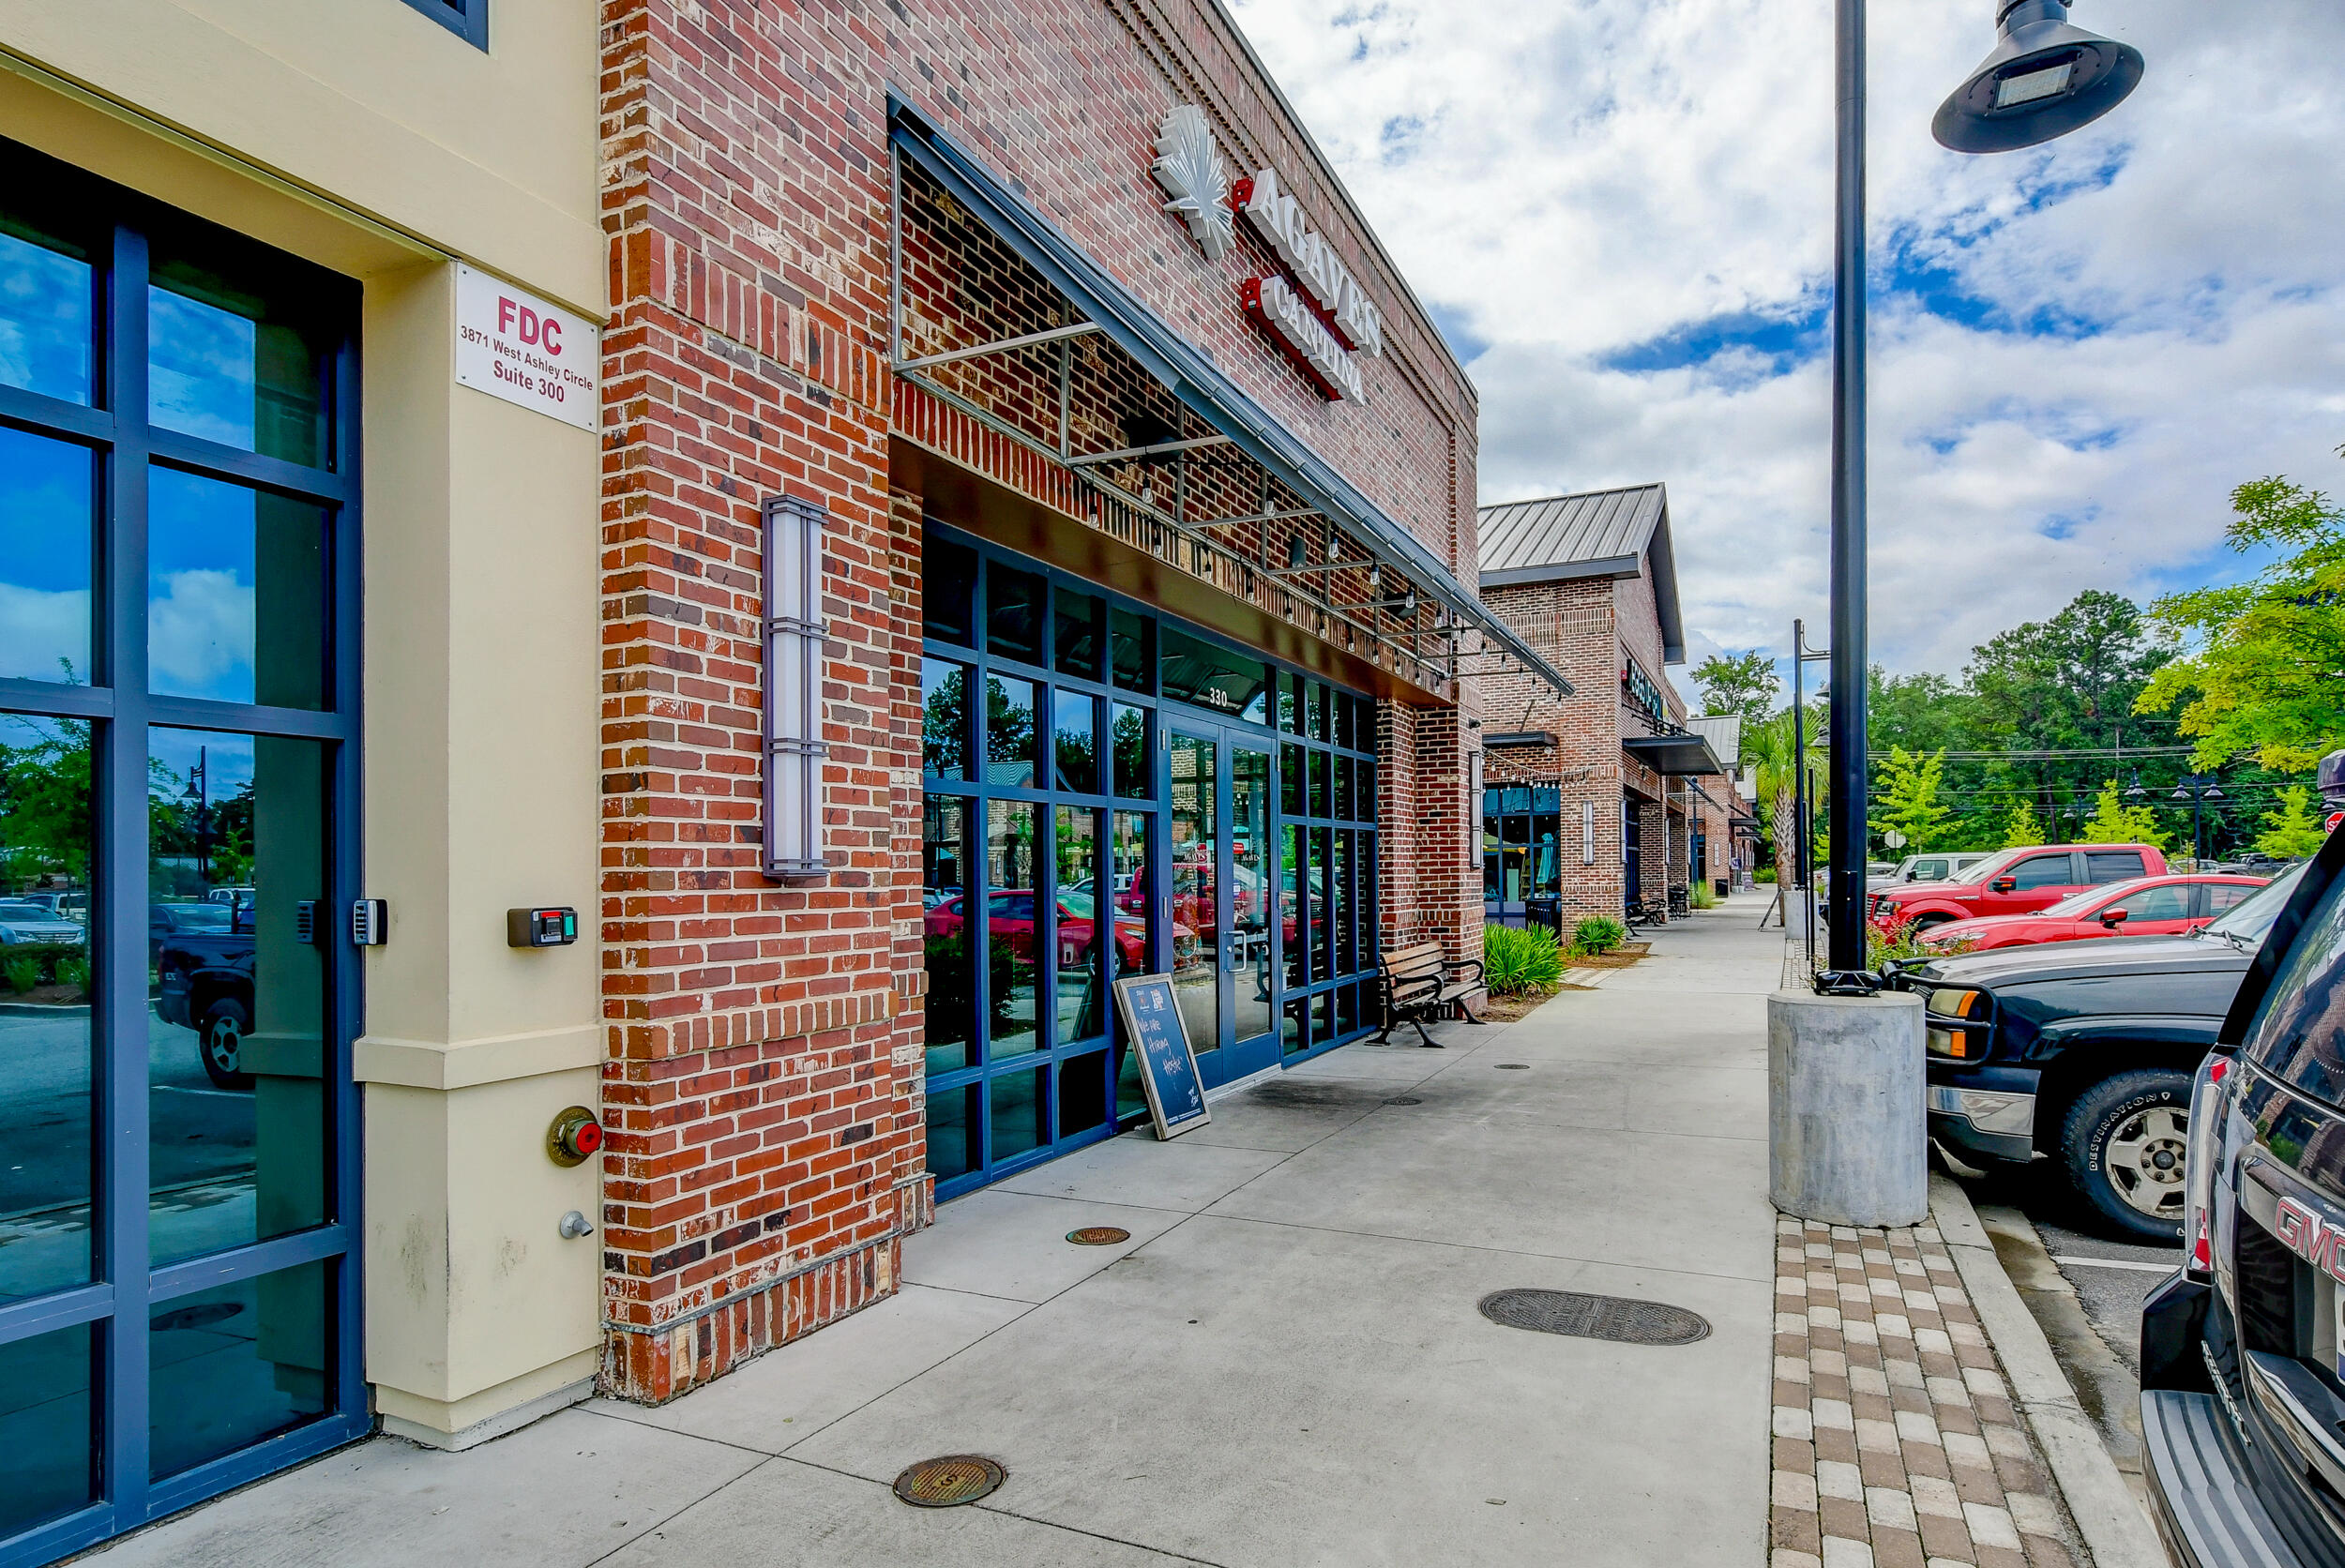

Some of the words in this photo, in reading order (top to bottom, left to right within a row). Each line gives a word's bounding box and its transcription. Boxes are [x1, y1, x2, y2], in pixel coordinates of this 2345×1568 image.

[1247, 168, 1382, 359] AGAVES
[461, 325, 489, 348] 3871
[493, 339, 521, 361] West
[524, 353, 560, 380] Ashley
[564, 369, 593, 391] Circle
[498, 295, 562, 356] FDC
[1261, 275, 1366, 407] CANTINA
[493, 360, 534, 390] Suite
[538, 378, 565, 402] 300
[1209, 687, 1228, 707] 330
[2088, 1093, 2157, 1171] DESTINATION
